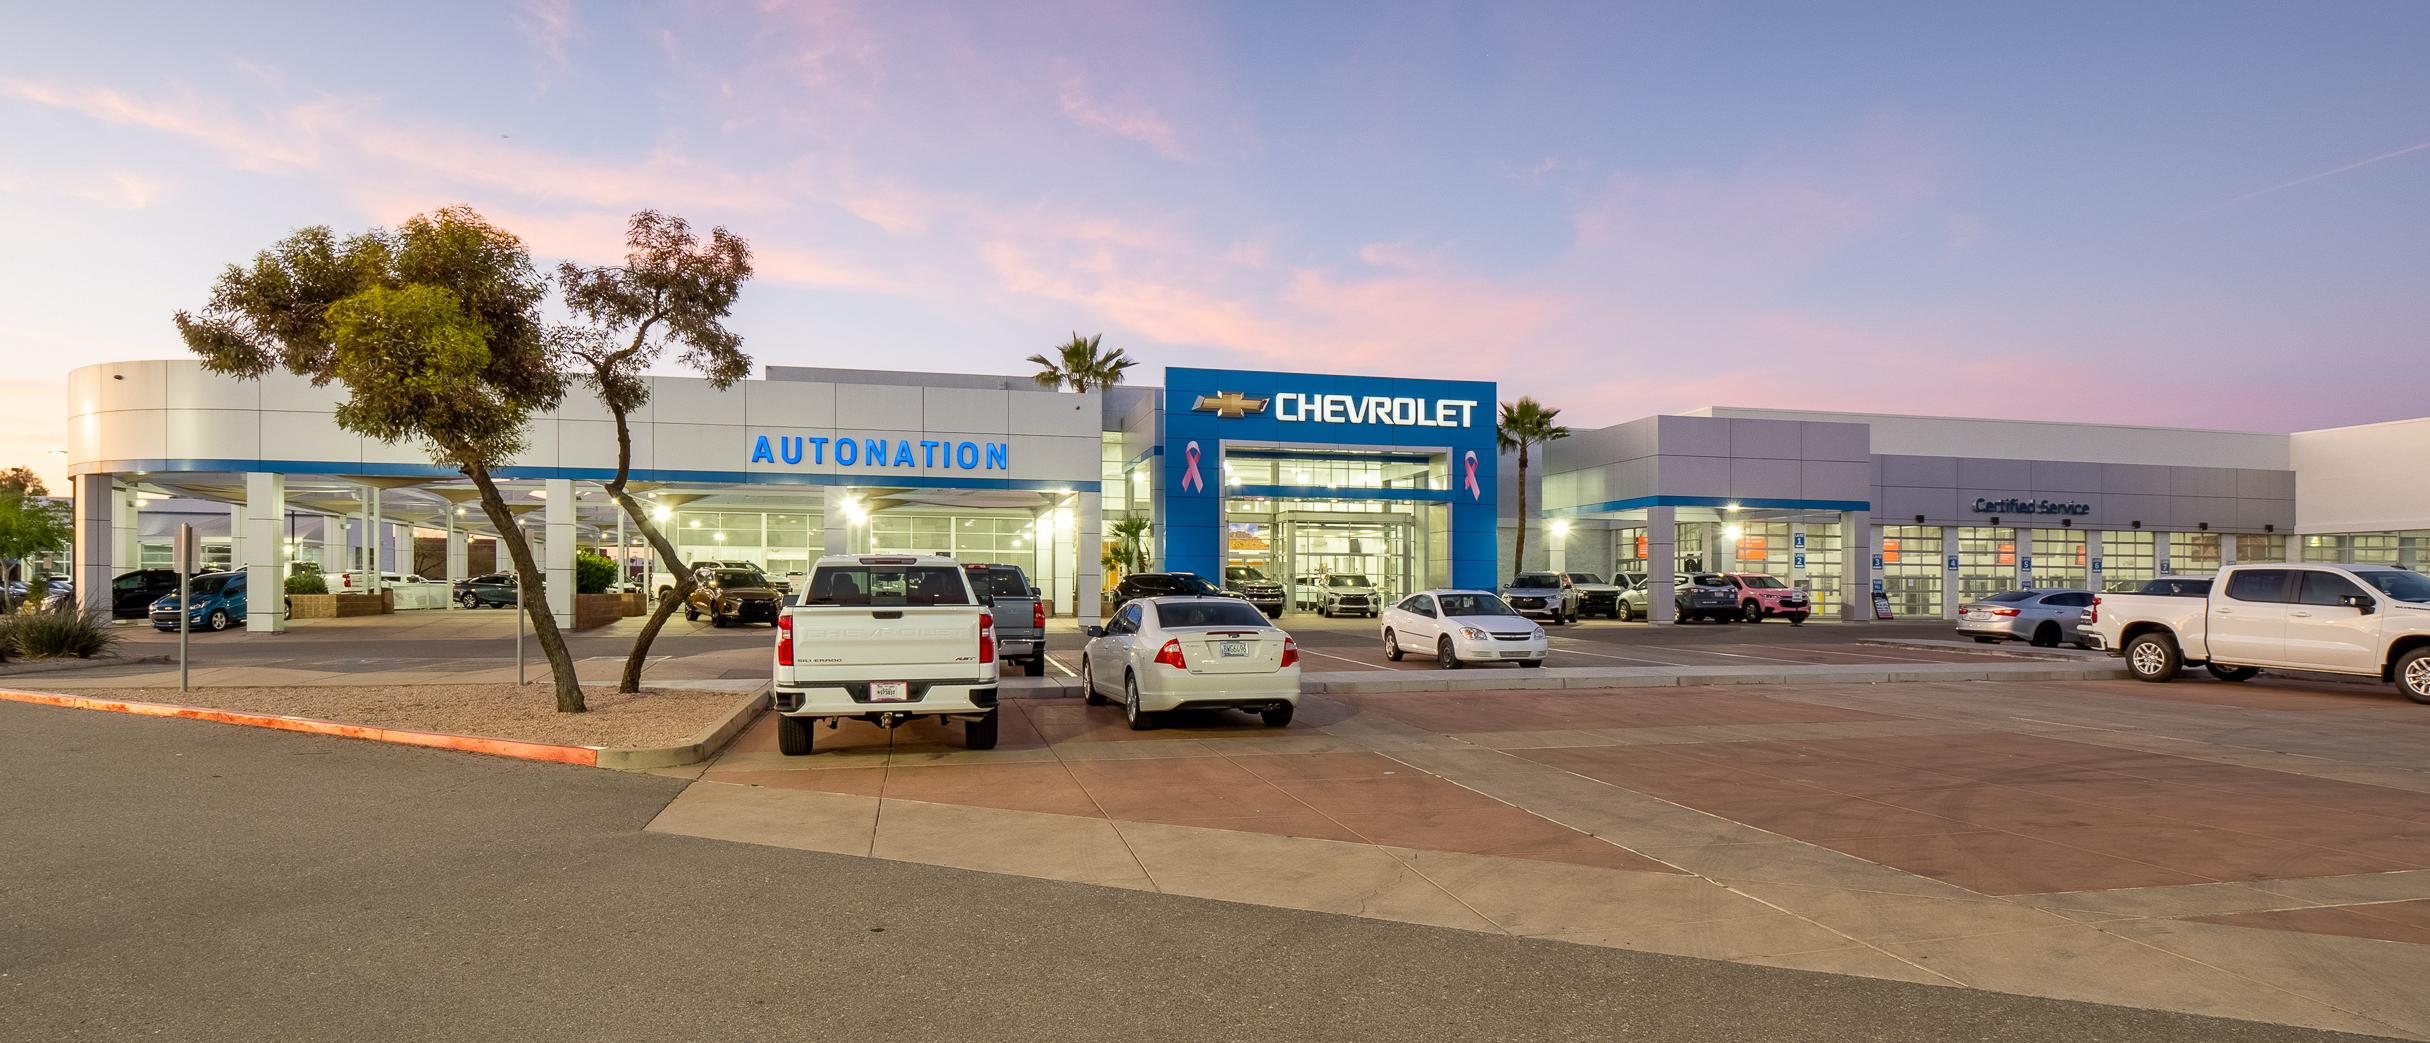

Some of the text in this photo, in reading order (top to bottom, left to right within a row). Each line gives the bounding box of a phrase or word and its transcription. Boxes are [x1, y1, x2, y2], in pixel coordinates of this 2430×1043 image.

[1275, 392, 1477, 428] CHEVROLET
[751, 435, 1007, 470] AUTONATION
[1975, 498, 2090, 515] Certified Service
